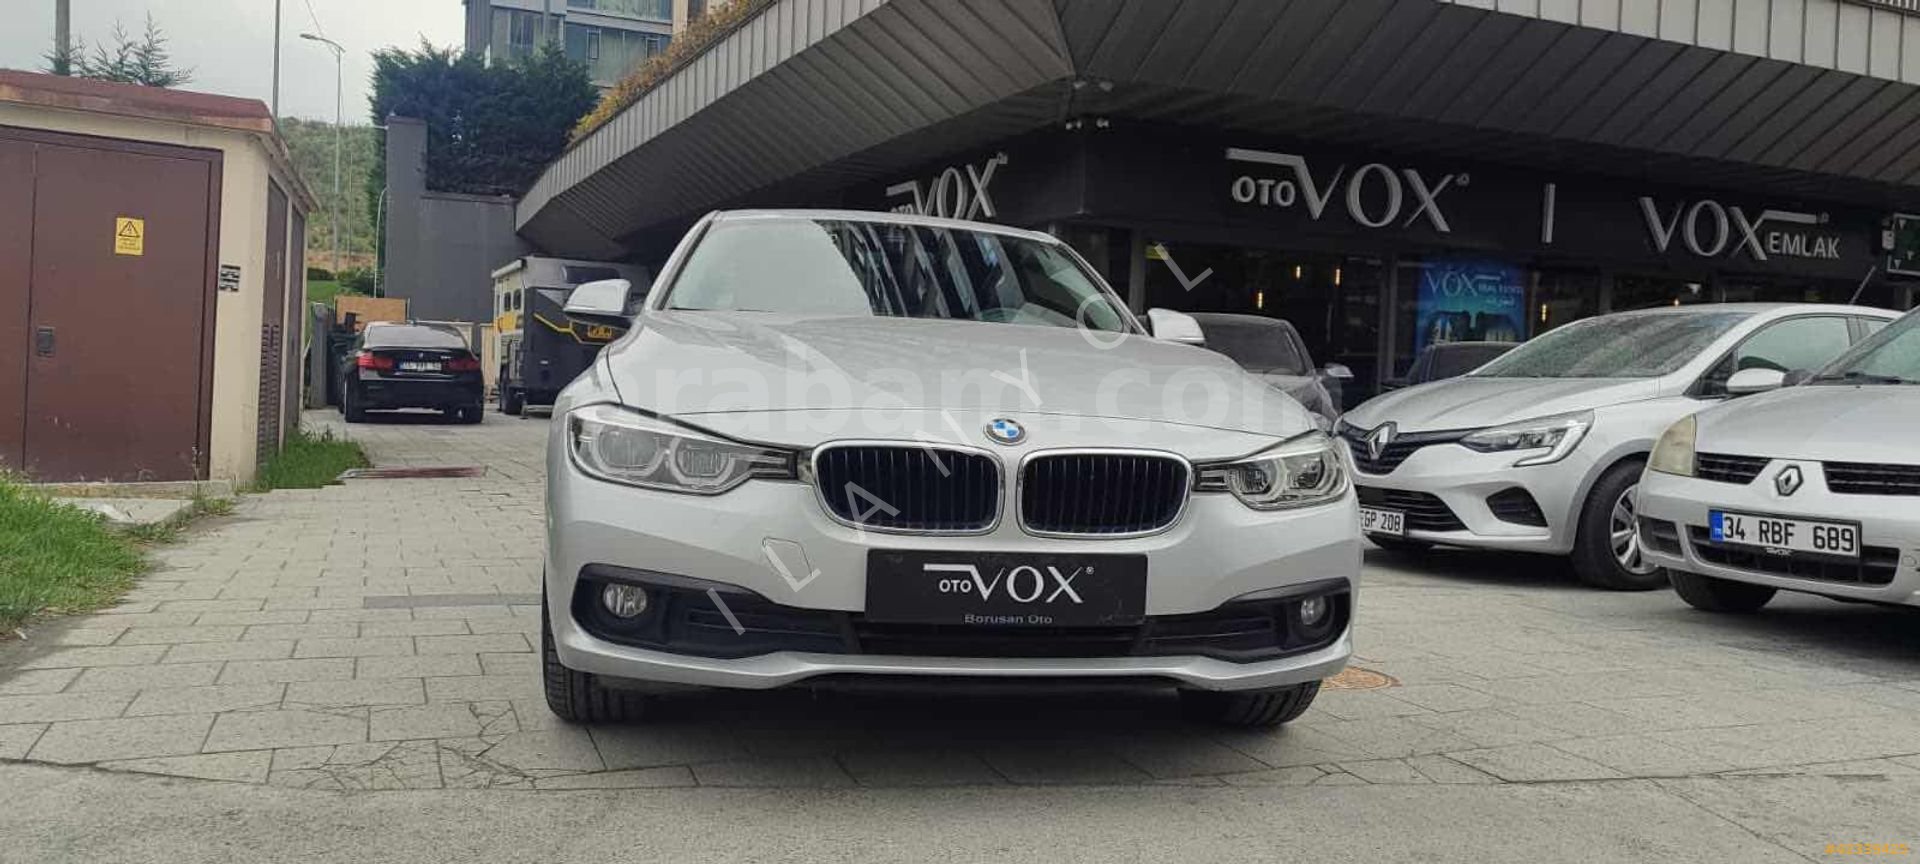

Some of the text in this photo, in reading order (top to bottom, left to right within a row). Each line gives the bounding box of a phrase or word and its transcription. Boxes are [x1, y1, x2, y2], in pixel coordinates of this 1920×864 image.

[1232, 154, 1451, 232] OTO VOX
[1640, 196, 1840, 261] VOX EMLAK
[1425, 269, 1479, 297] VOX
[1381, 512, 1401, 532] 208
[1723, 516, 1855, 552] 34 RBF 689
[938, 563, 1084, 604] OTO VOX
[964, 613, 1053, 625] Borusan Oto
